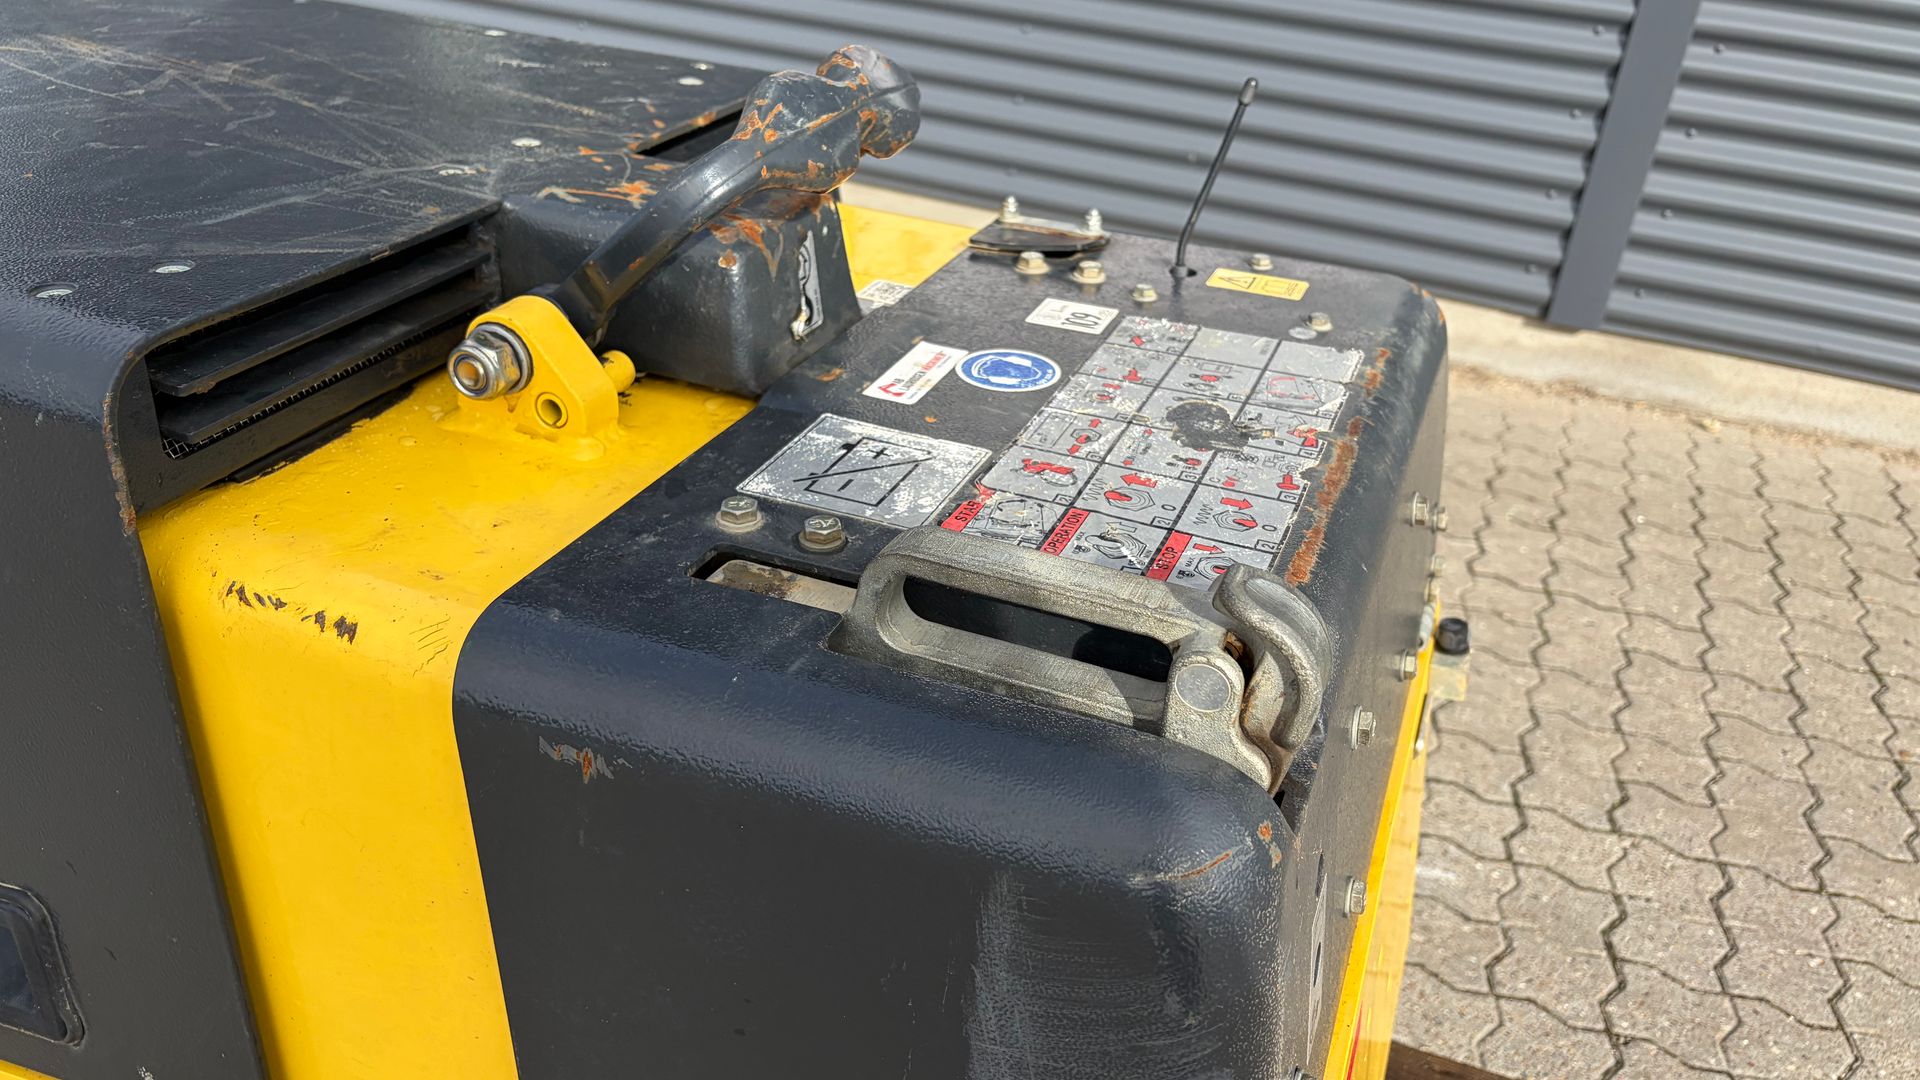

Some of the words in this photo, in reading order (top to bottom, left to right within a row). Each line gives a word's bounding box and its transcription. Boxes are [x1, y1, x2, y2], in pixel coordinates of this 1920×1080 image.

[1061, 311, 1102, 330] 109
[1043, 511, 1084, 554] OPERATION
[1157, 519, 1170, 527] 2
[1155, 546, 1178, 570] STOP
[1184, 556, 1196, 568] MAX
